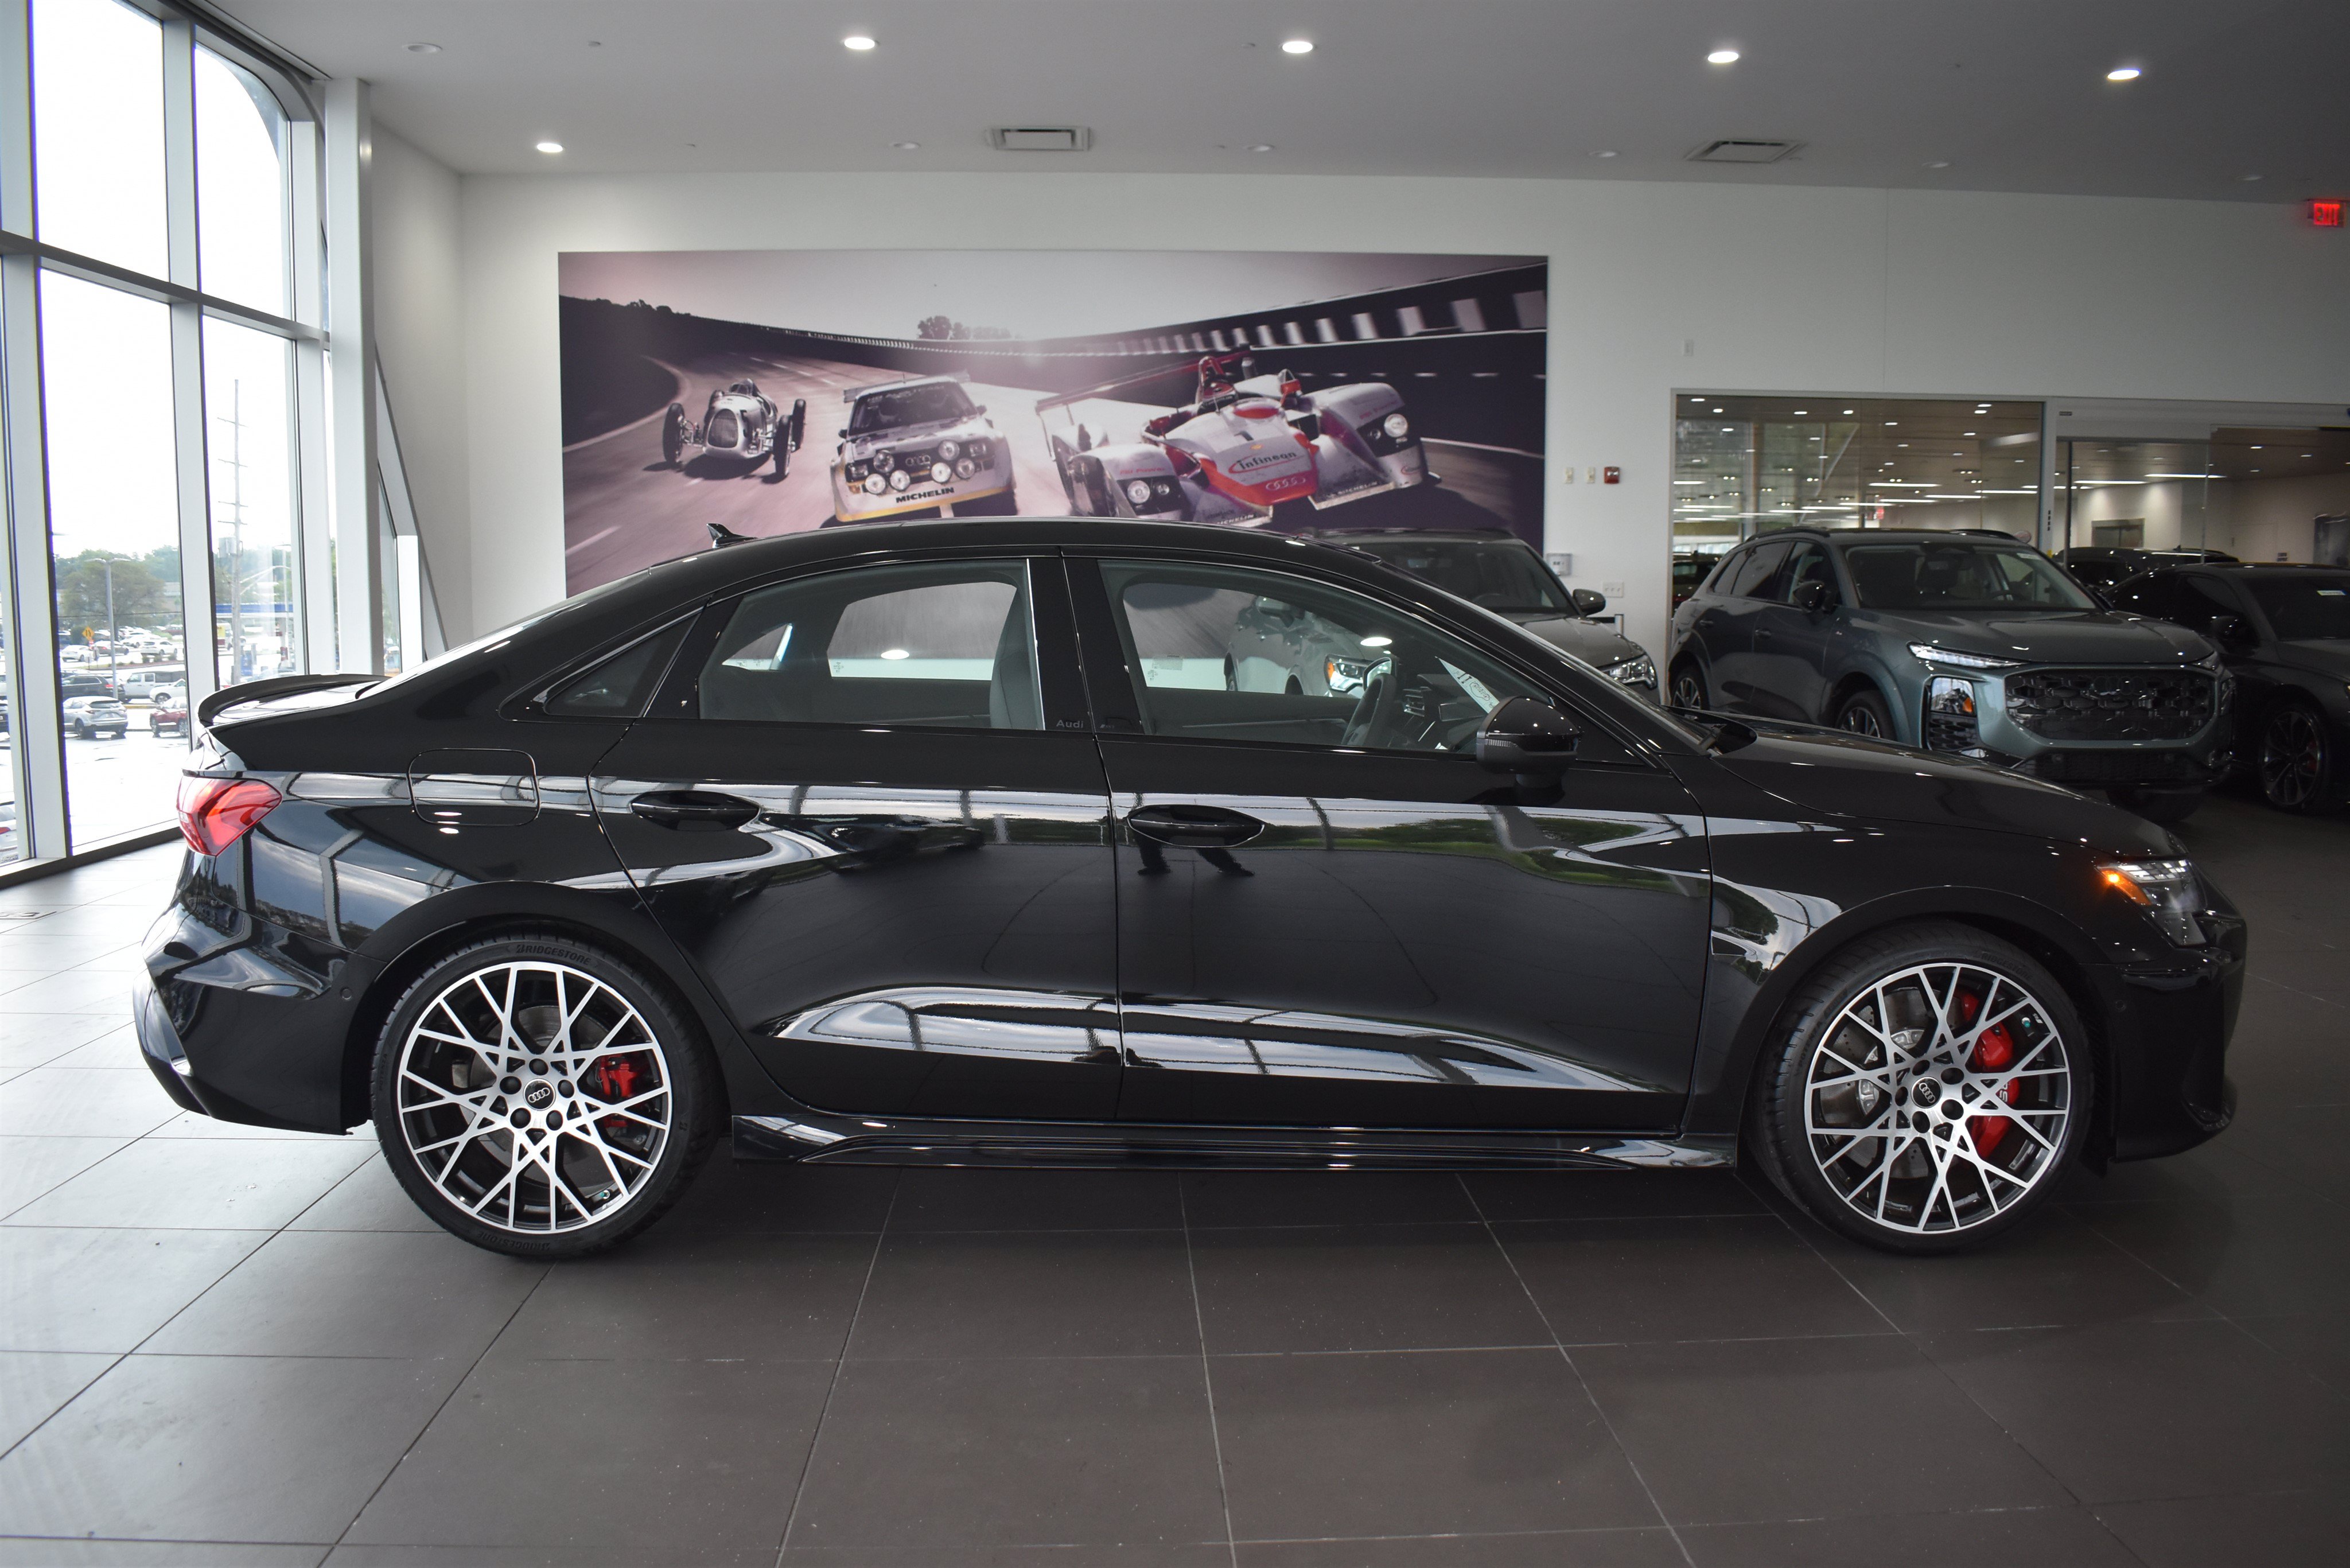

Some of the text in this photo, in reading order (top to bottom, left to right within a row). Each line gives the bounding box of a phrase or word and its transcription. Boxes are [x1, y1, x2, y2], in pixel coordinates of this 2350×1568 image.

[2313, 203, 2340, 225] EXIT
[1236, 451, 1297, 470] Infineon
[896, 487, 955, 503] MICHELIN
[1056, 719, 1083, 729] Audi
[516, 944, 592, 966] BRIDGESTONE
